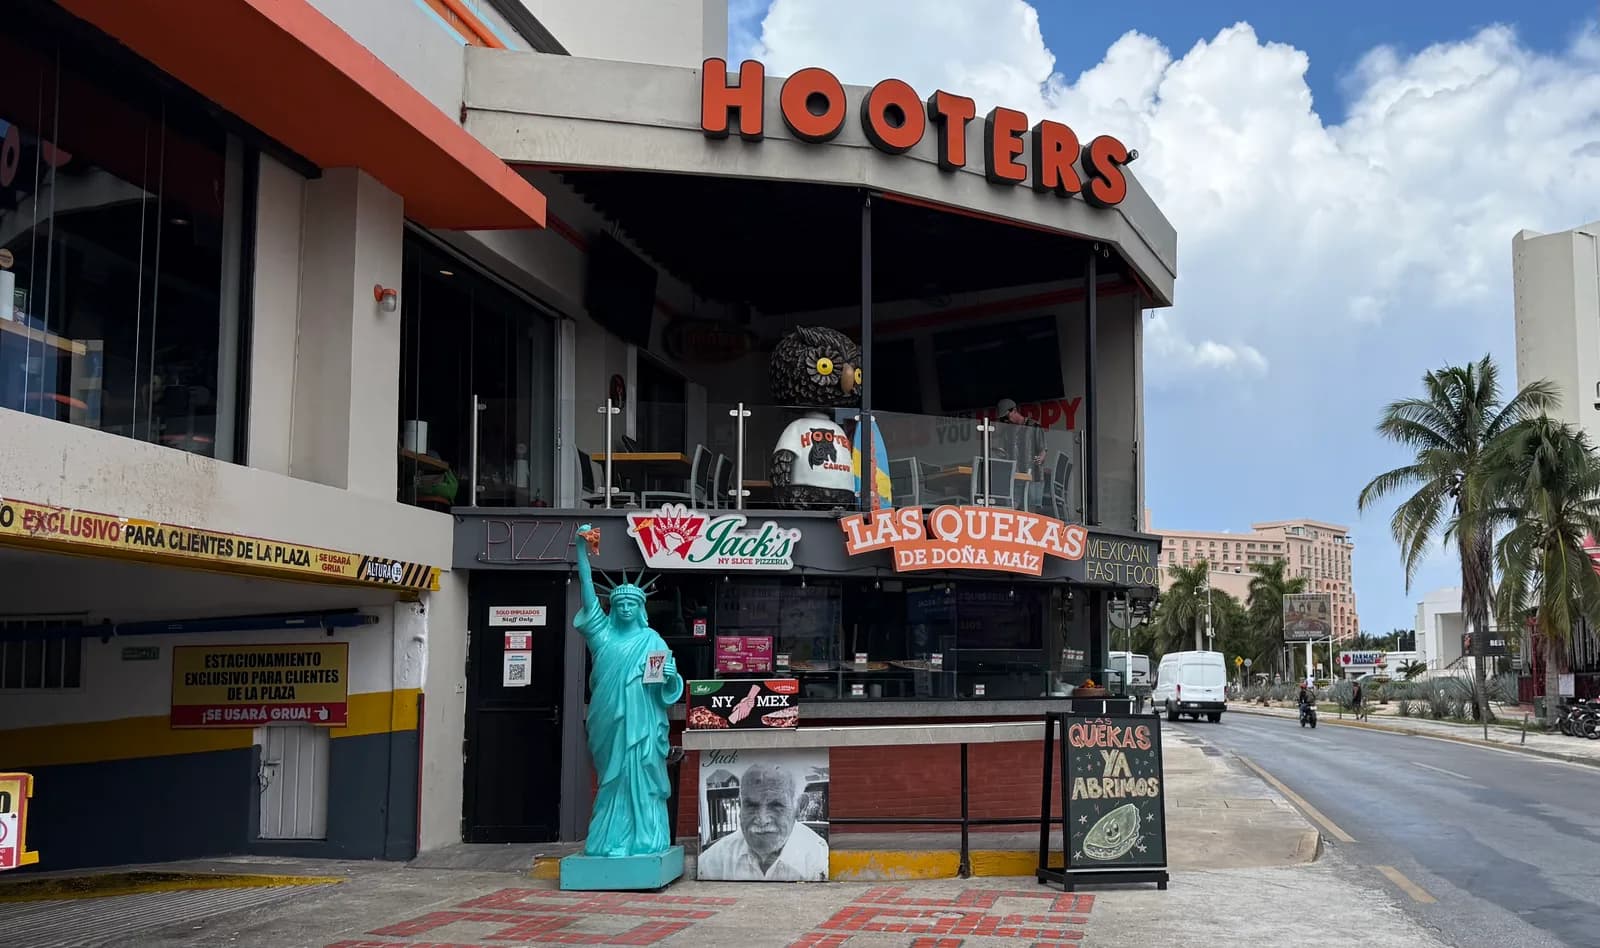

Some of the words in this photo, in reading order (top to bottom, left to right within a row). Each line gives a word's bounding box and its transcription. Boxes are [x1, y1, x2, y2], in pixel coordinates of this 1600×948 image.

[701, 57, 1129, 207] HOOTERS
[23, 508, 120, 541] EXCLUSIVO
[125, 525, 165, 548] PARA
[169, 530, 234, 557] CLIENTES
[237, 541, 253, 559] DE
[257, 544, 272, 562] LA
[275, 546, 310, 567] PLAZA
[688, 518, 791, 562] Jack's
[847, 510, 922, 550] LAS
[936, 509, 1083, 557] QUEKAS
[899, 549, 927, 566] DE
[932, 544, 989, 564] DOÑA
[1086, 538, 1150, 563] MEXICAN
[367, 561, 391, 579] ALTURA
[1087, 561, 1122, 582] FAST
[1127, 564, 1164, 585] FOOD
[205, 652, 321, 668] ESTACIONAMIENTO
[185, 671, 249, 686] EXCLUSIVO
[252, 670, 282, 684] PARA
[285, 669, 339, 684] CLIENTES
[227, 687, 242, 701] DE
[245, 686, 258, 700] LA
[261, 686, 295, 700] PLAZA
[711, 696, 734, 708] NY
[757, 695, 790, 706] MEX
[224, 705, 267, 721] USARÁ
[271, 707, 311, 719] GRUA!
[1084, 717, 1112, 725] LAS
[1068, 722, 1151, 750] QUEKAS
[1100, 750, 1132, 778] YA
[1072, 776, 1160, 800] ABRIMOS
